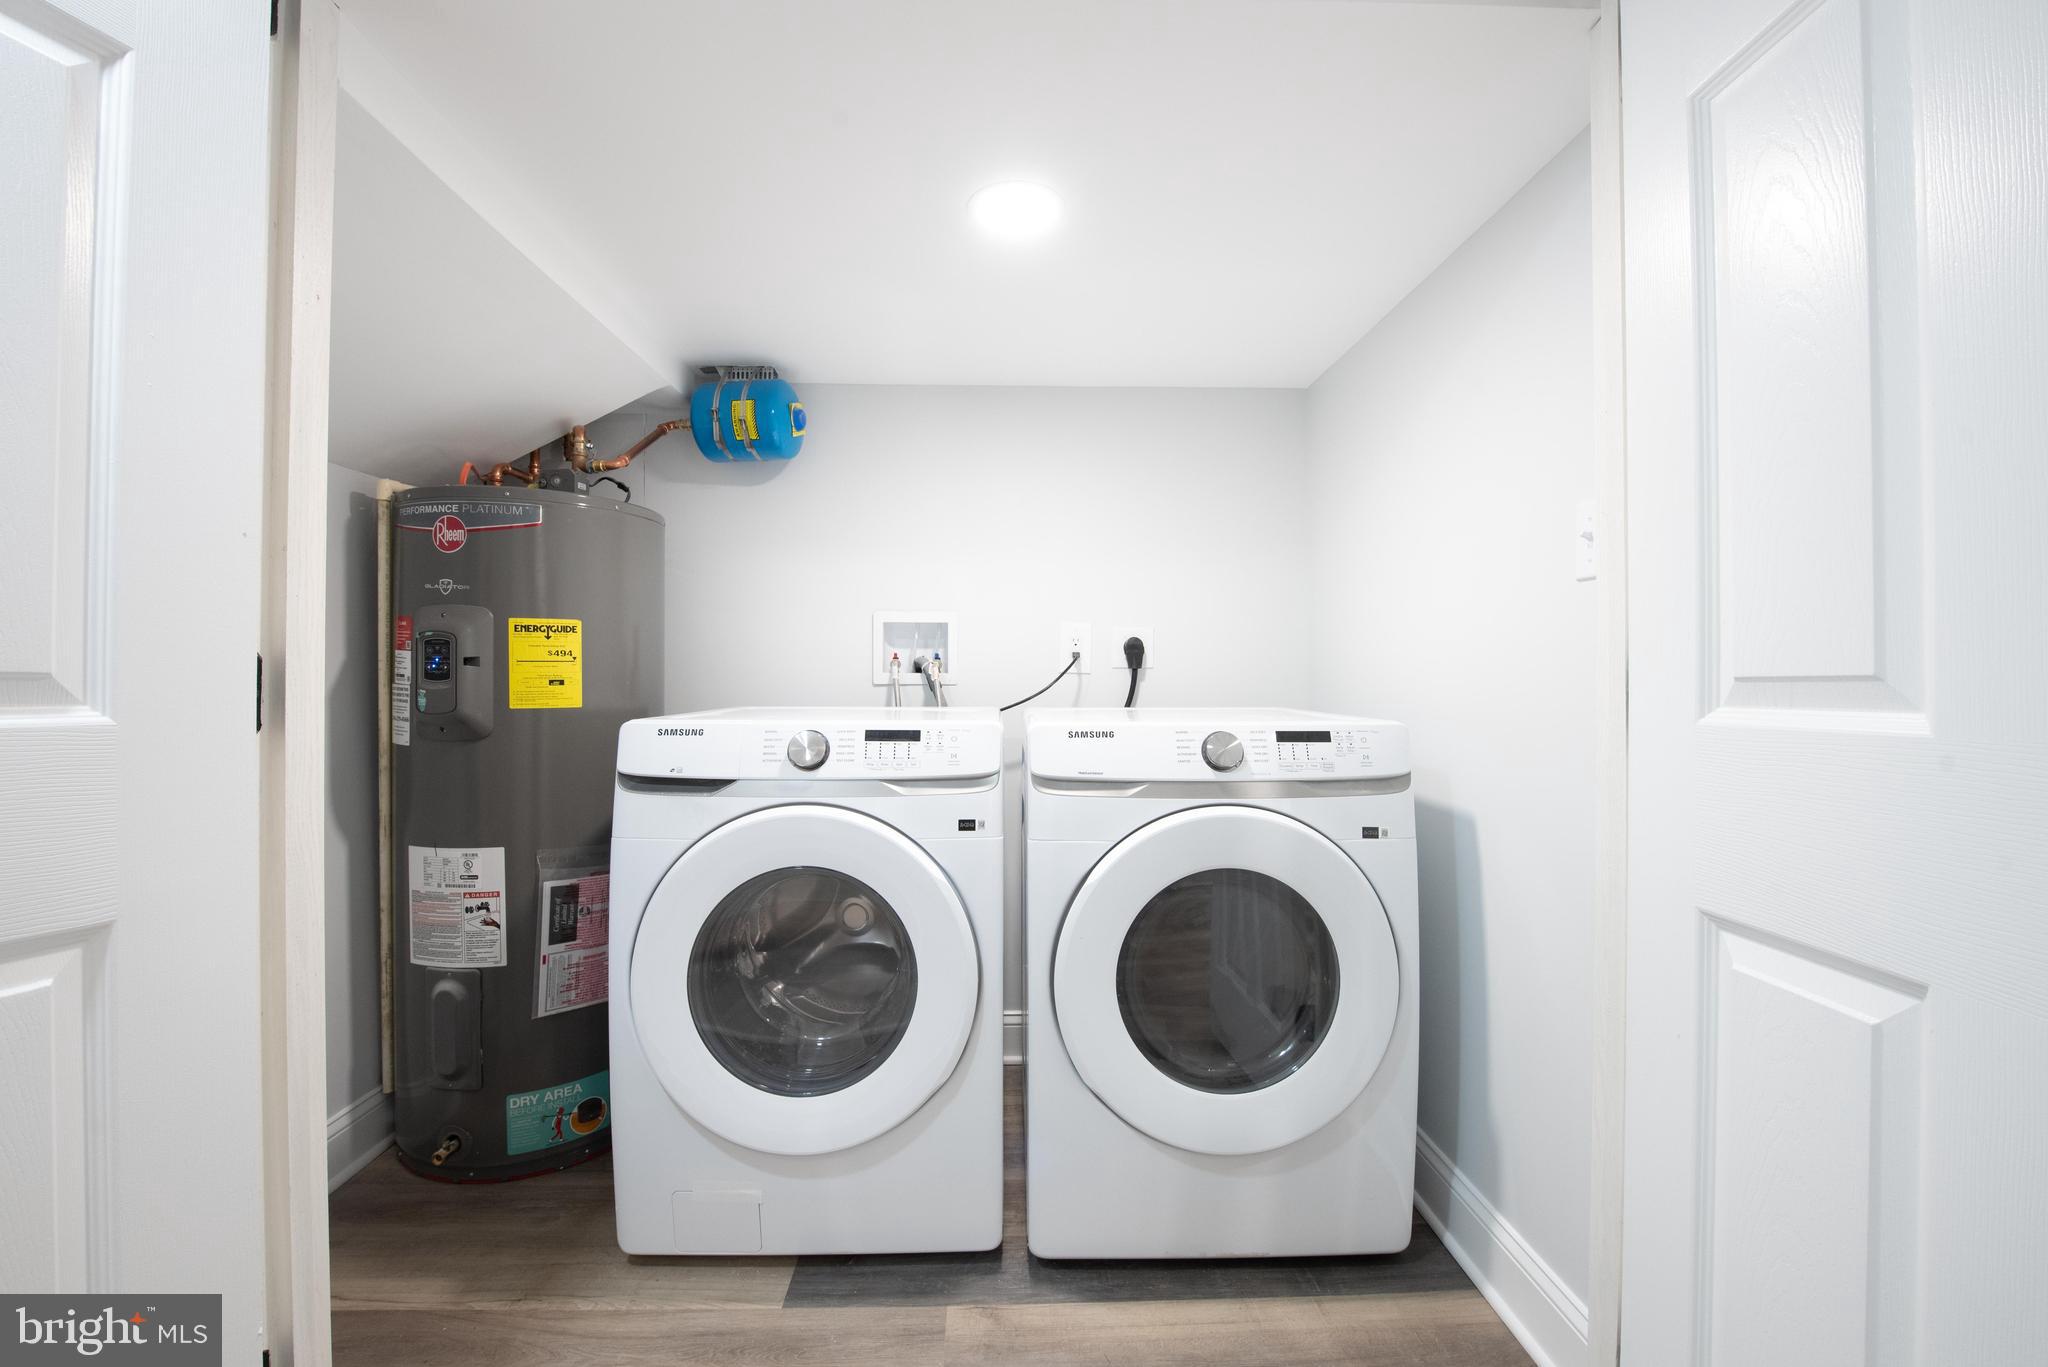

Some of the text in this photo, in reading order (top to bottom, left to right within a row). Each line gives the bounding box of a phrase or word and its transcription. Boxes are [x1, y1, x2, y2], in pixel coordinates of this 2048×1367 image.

[399, 503, 523, 516] PERFORMANCE PLATINUM
[436, 516, 465, 547] Rheem
[514, 624, 578, 635] ENERGYGUIDE
[657, 728, 704, 737] SAMSUNG
[1067, 730, 1115, 739] SAMSUNG
[510, 1094, 540, 1109] DRY
[543, 1083, 583, 1103] AREA
